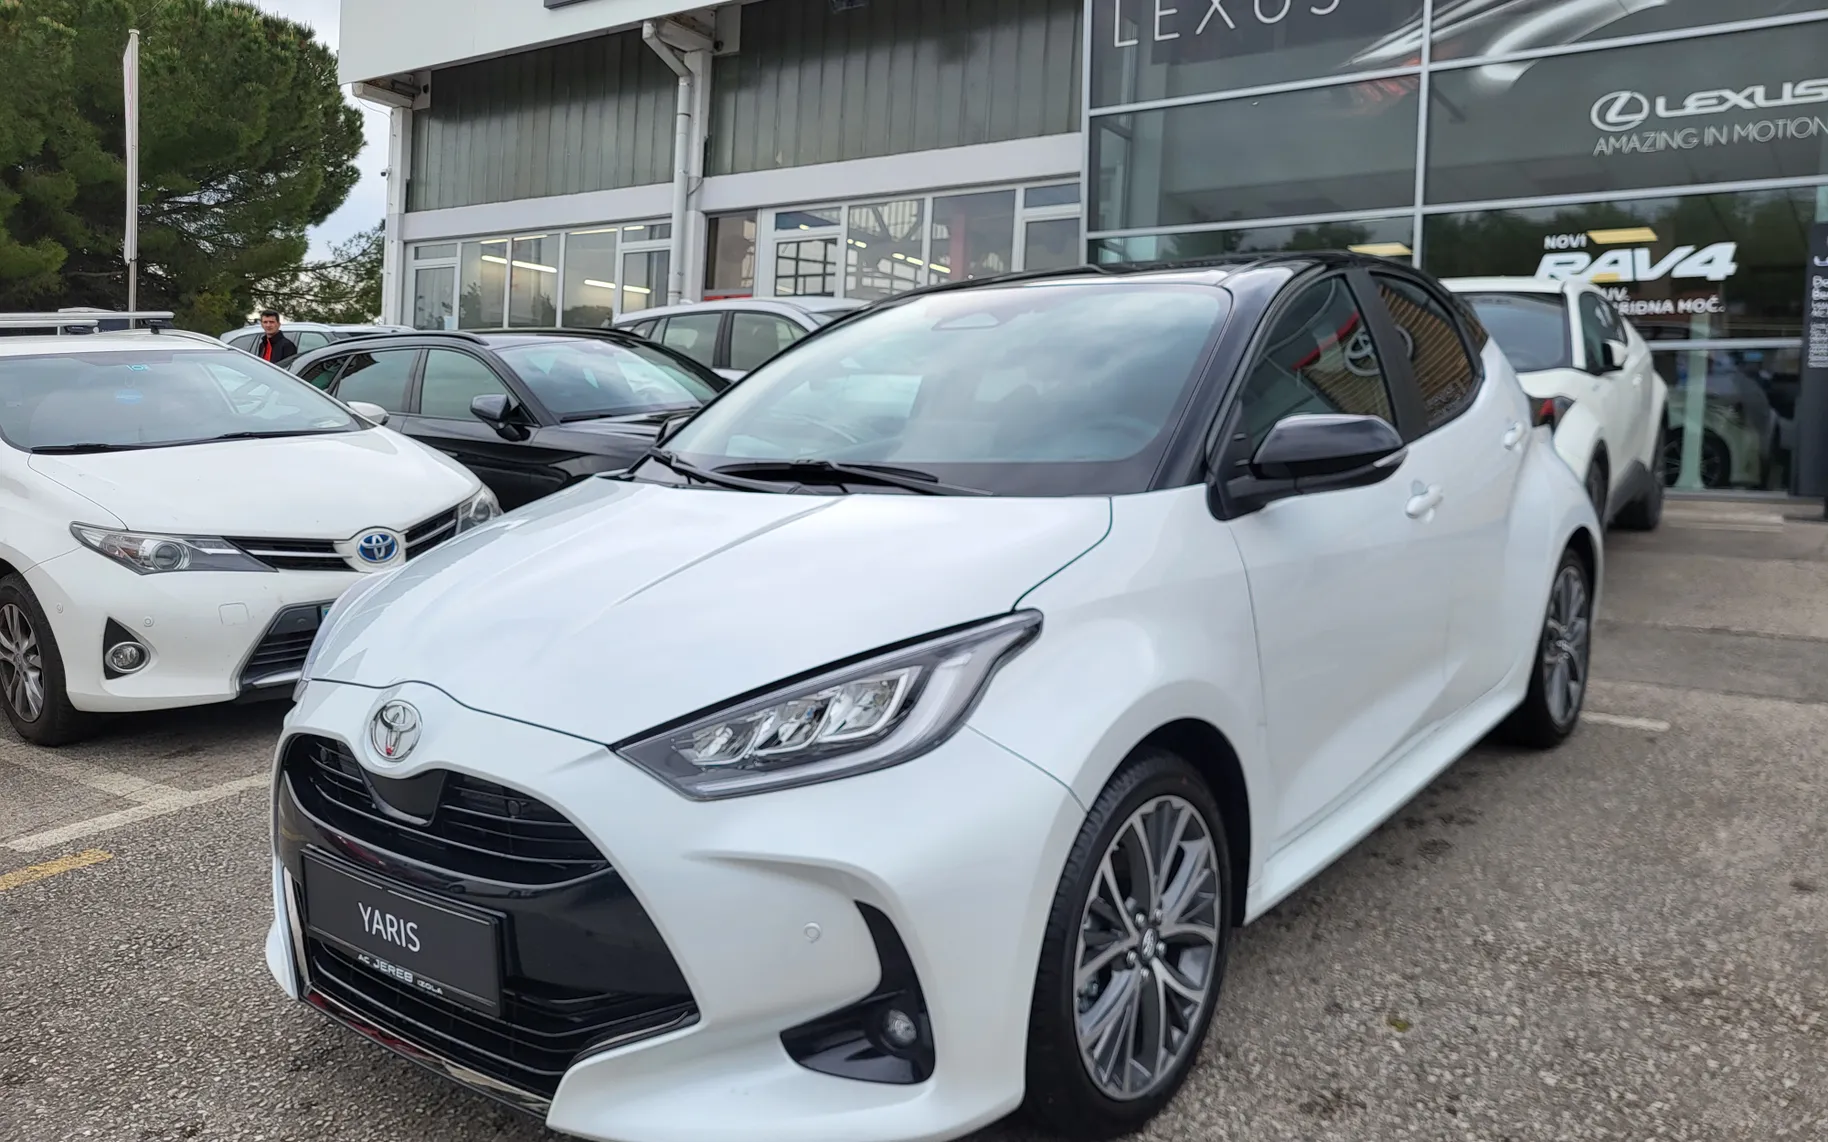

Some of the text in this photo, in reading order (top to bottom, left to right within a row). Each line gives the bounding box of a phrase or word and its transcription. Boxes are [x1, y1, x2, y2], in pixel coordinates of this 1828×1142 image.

[1113, 0, 1340, 48] LEX
[1654, 77, 1828, 118] LEXUS
[1592, 115, 1828, 157] AMAZING IN MOTION
[1533, 241, 1738, 282] RAV4
[1543, 233, 1588, 250] NOVI
[1612, 299, 1676, 316] RIDNA
[357, 901, 421, 952] YARIS
[357, 953, 371, 965] AC
[373, 959, 414, 984] JEREB
